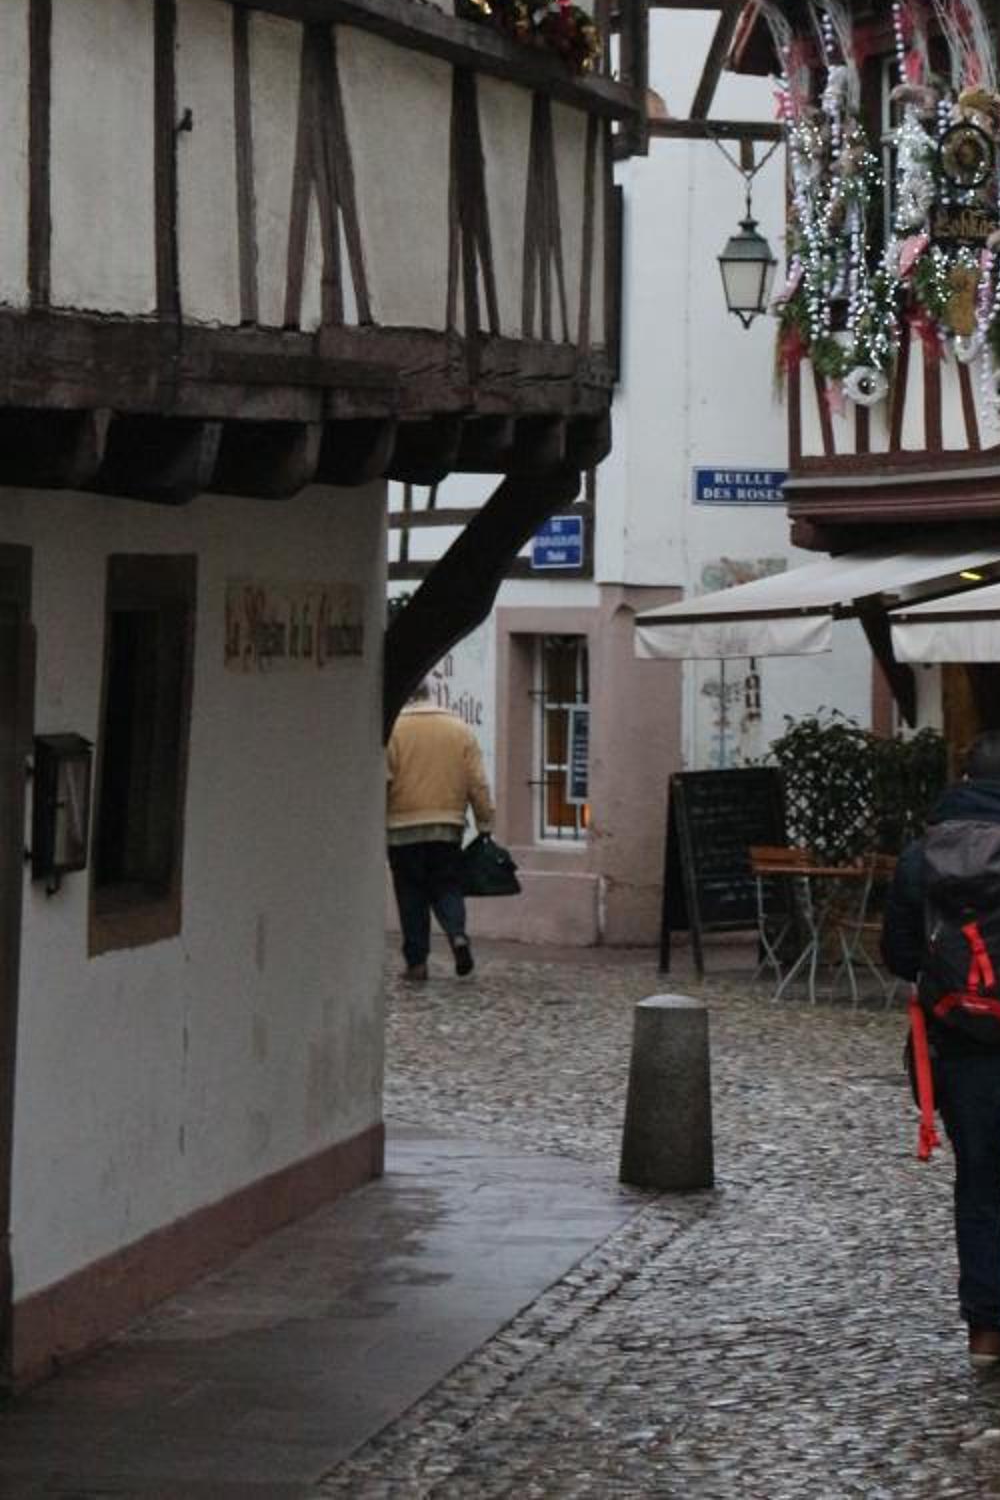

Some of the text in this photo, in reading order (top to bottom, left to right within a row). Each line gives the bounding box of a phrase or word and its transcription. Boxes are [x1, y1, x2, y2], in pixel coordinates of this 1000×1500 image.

[714, 473, 774, 485] RUELLE
[703, 487, 784, 500] DES ROSES
